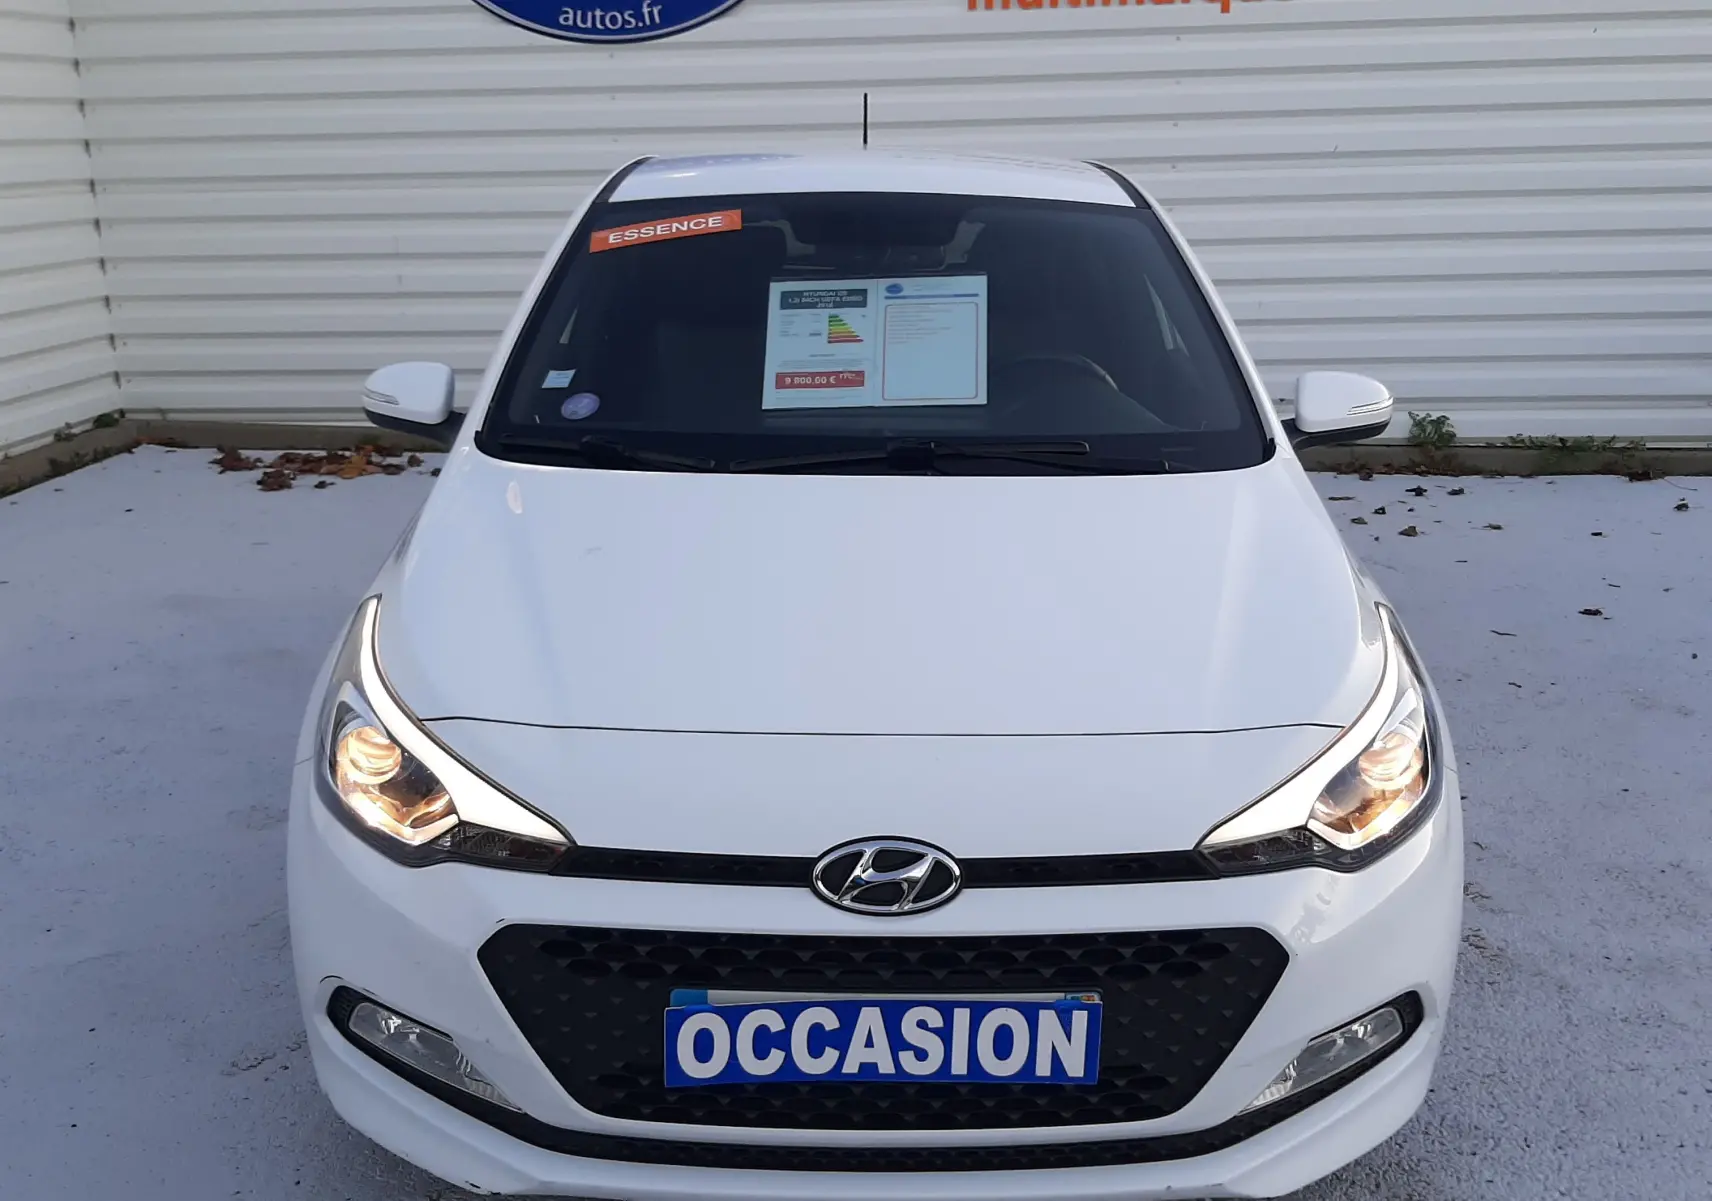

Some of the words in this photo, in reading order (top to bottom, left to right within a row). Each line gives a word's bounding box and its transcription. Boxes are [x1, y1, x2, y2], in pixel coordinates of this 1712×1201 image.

[559, 0, 662, 29] autos.fr
[608, 216, 724, 244] ESSENCE
[676, 1006, 1090, 1078] OCCASION
